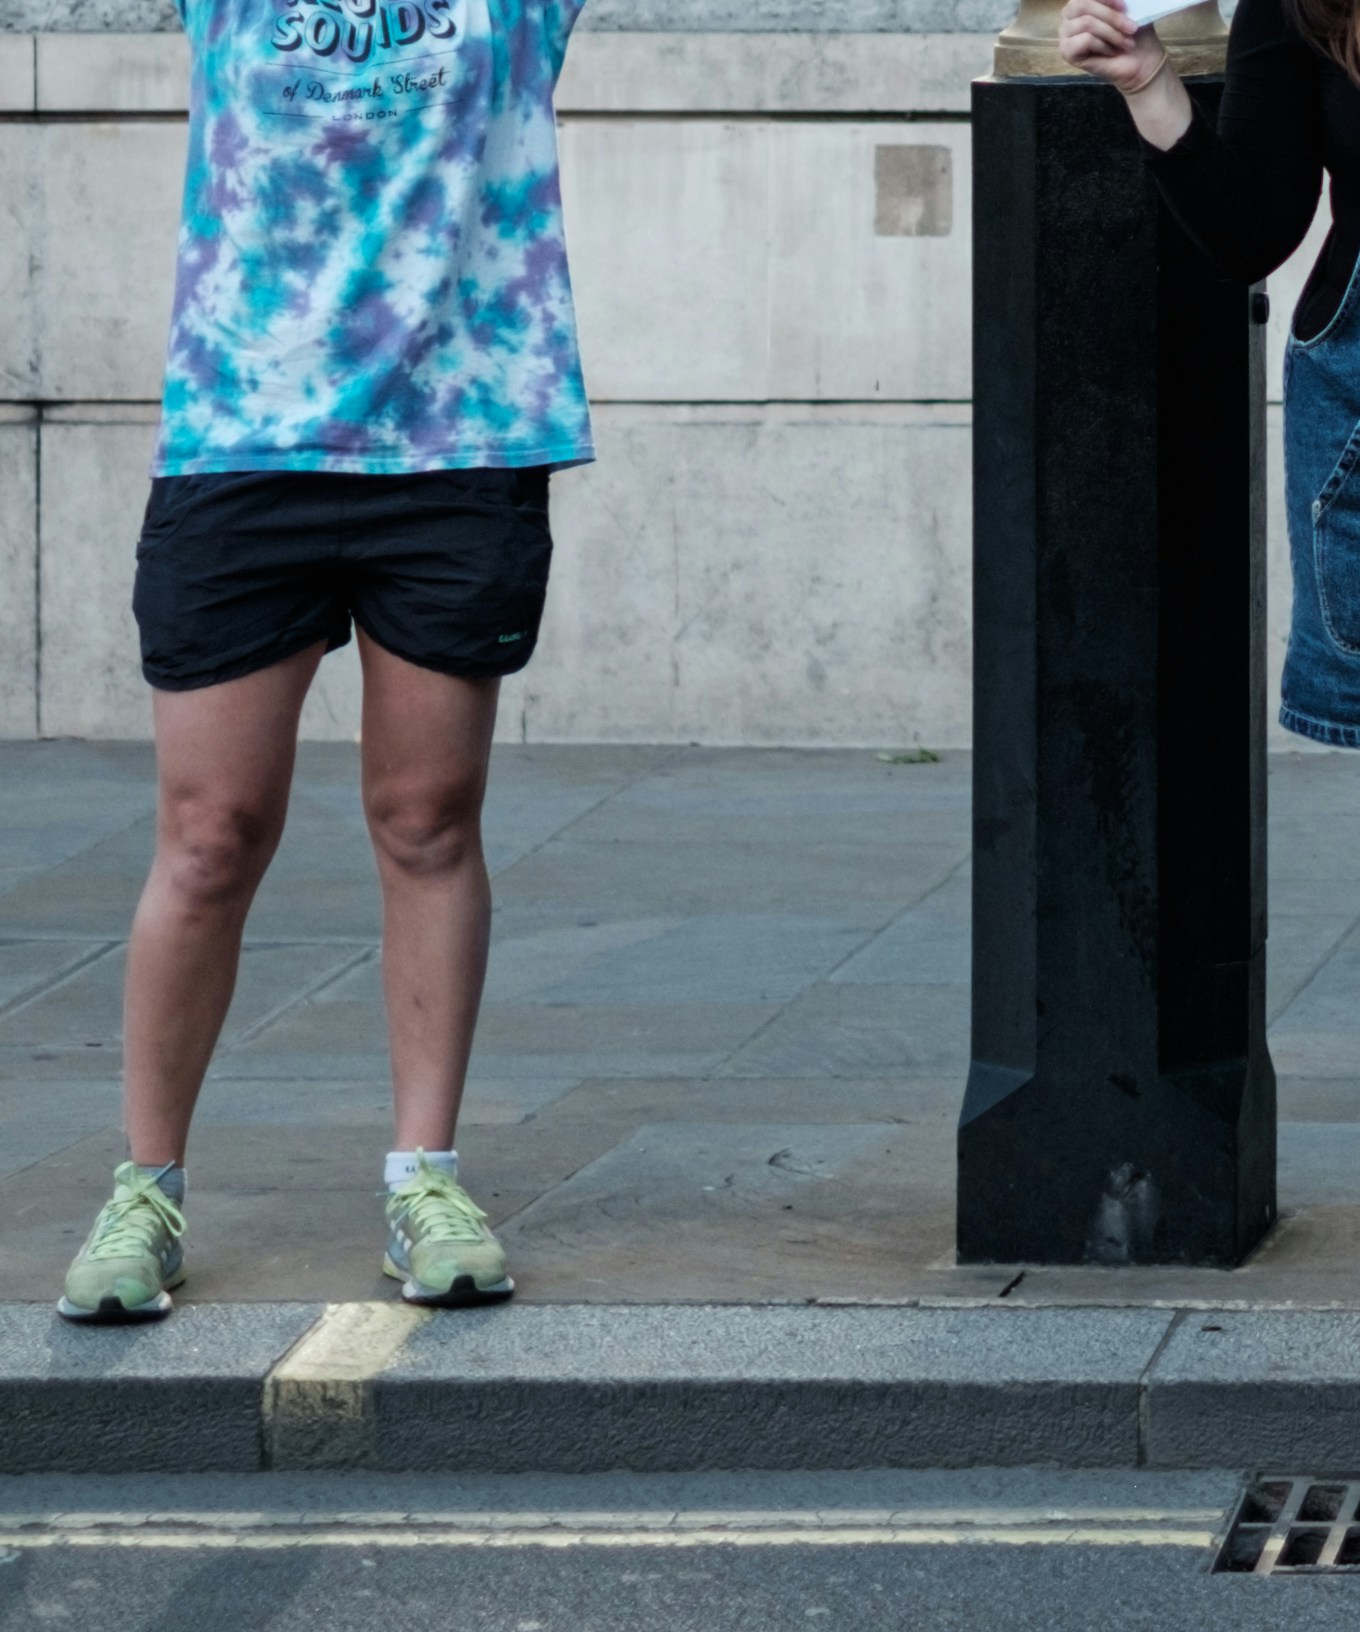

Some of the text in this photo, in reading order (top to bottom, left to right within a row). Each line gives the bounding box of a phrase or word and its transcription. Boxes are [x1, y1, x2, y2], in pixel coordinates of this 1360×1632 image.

[282, 66, 447, 103] of Denmark Street
